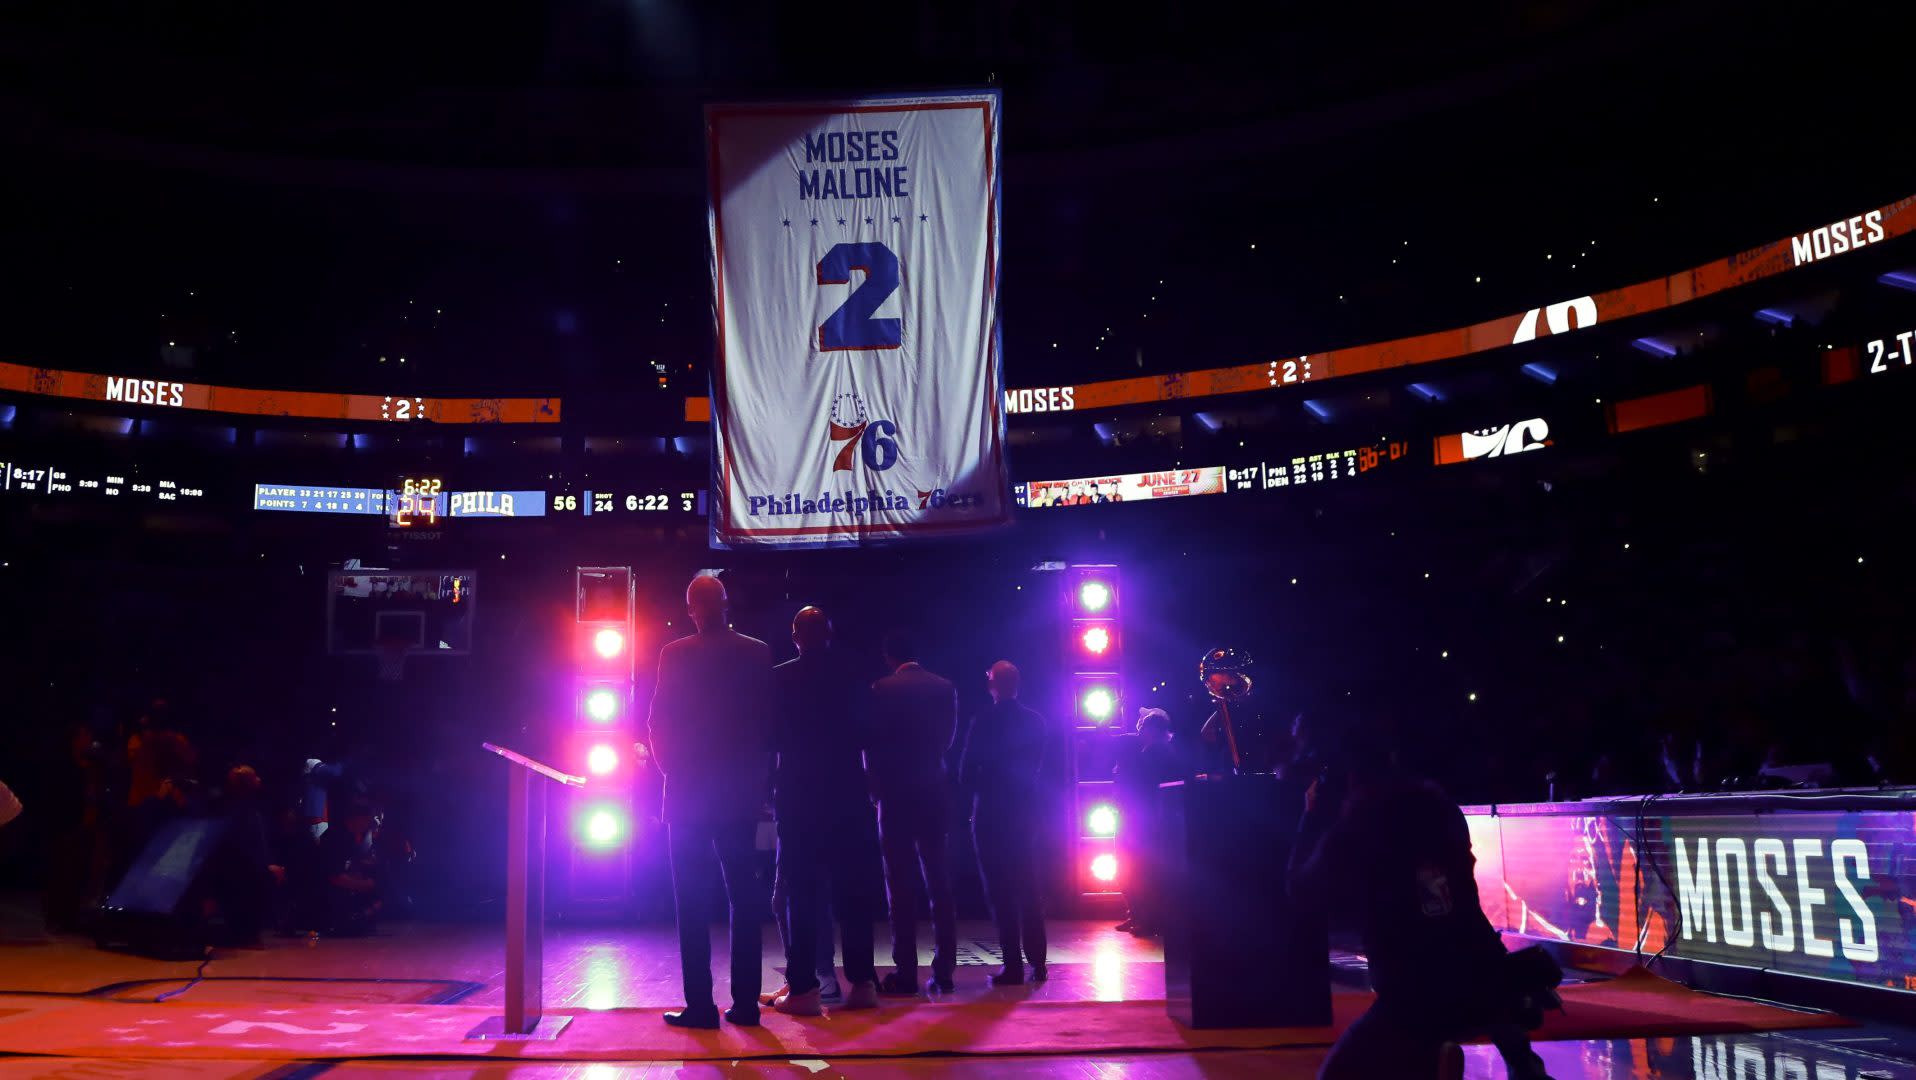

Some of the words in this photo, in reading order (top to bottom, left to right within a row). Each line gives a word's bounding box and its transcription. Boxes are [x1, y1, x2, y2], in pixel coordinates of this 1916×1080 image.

[805, 130, 899, 163] MOSES
[799, 166, 909, 200] MALONE
[1791, 210, 1884, 267] MOSES
[816, 242, 902, 351] 2
[1867, 330, 1916, 374] 2-T
[1282, 361, 1298, 383] 2
[106, 376, 184, 407] MOSES
[1004, 387, 1075, 414] MOSES
[395, 400, 411, 419] 2
[830, 419, 897, 472] 76
[13, 467, 46, 482] 8:17
[1228, 466, 1259, 481] 8:17
[1268, 466, 1287, 478] PHI
[1293, 463, 1307, 475] 24
[1310, 461, 1323, 472] 13
[1330, 459, 1338, 469] 2
[1347, 456, 1355, 467] 2
[20, 481, 36, 490] PM
[52, 483, 72, 492] PHO
[159, 480, 176, 489] MIA
[404, 479, 442, 496] 6:22
[1137, 472, 1177, 488] JUNE
[1181, 469, 1200, 484] 27
[1237, 480, 1252, 490] PM
[1267, 476, 1290, 489] DEN
[1294, 474, 1307, 485] 22
[1311, 472, 1324, 482] 19
[1331, 469, 1338, 480] 2
[1347, 467, 1356, 477] 4
[105, 487, 119, 496] NO
[158, 492, 176, 500] SAC
[258, 487, 296, 497] PLAYER
[327, 490, 338, 499] 17
[259, 499, 296, 508] POINTS
[301, 501, 308, 509] 7
[314, 501, 323, 510] 4
[355, 503, 363, 511] 4
[397, 497, 436, 526] 24
[449, 491, 514, 516] PHILA
[553, 495, 577, 511] 56
[594, 500, 614, 512] 24
[625, 494, 669, 511] 6:22
[683, 500, 692, 511] 3
[749, 490, 910, 518] Philadelphia
[1674, 837, 1880, 963] MOSES
